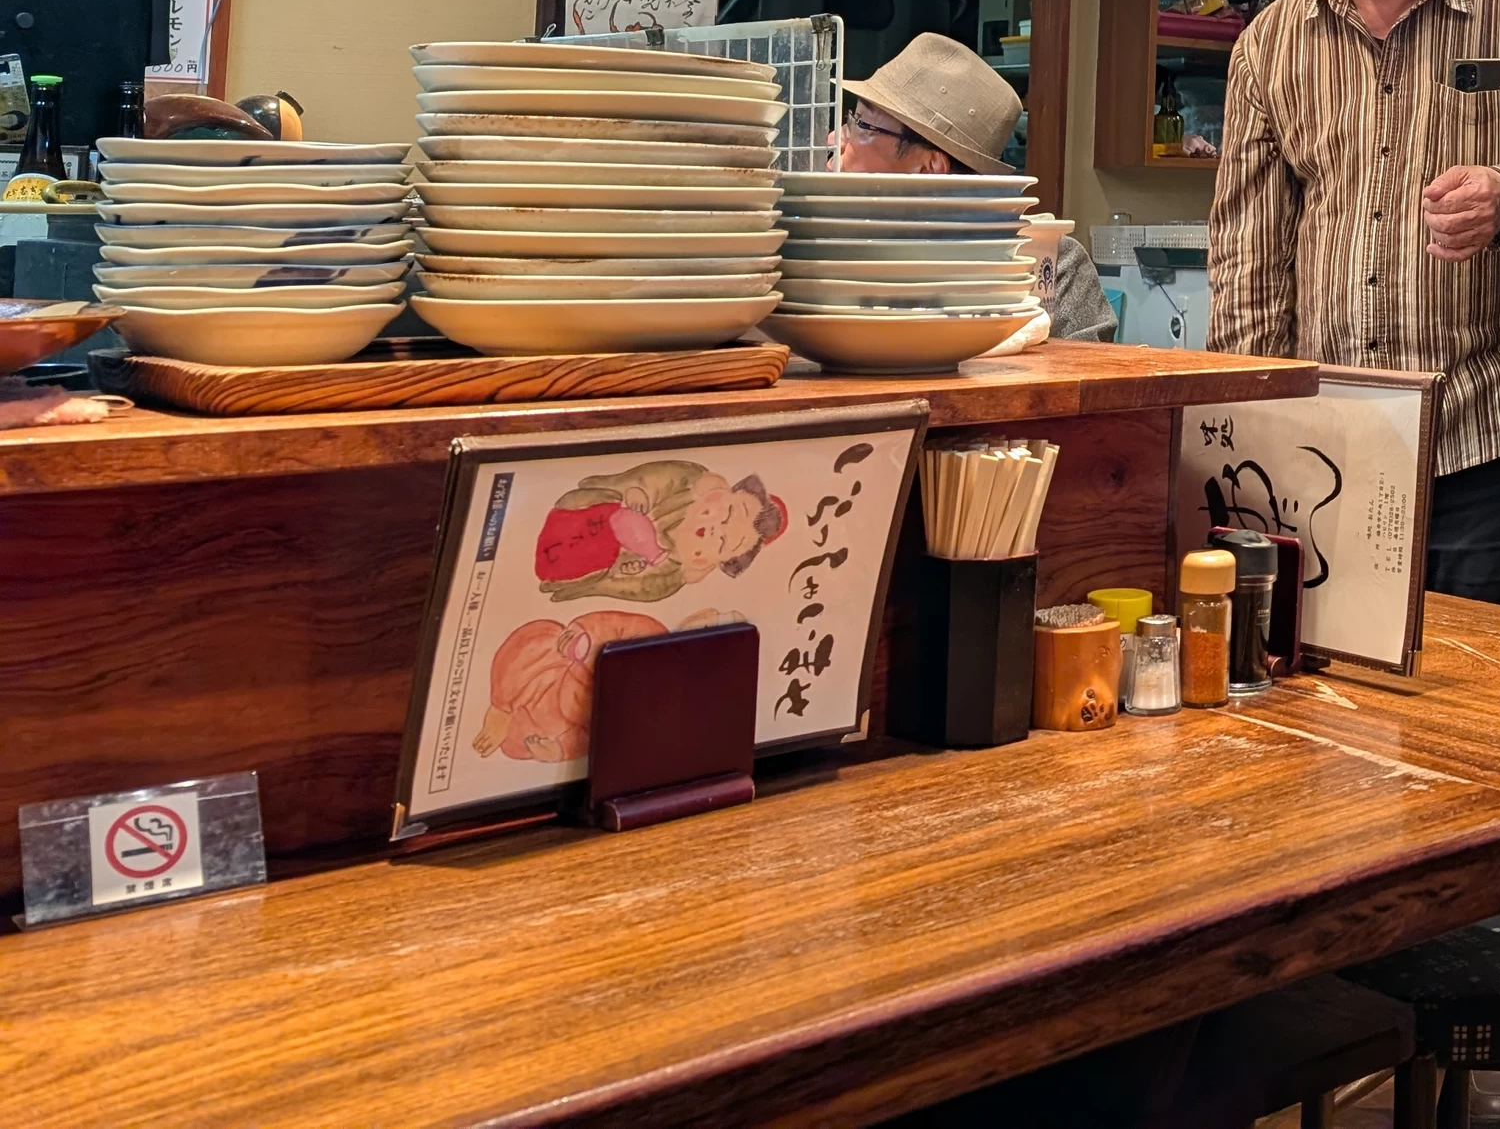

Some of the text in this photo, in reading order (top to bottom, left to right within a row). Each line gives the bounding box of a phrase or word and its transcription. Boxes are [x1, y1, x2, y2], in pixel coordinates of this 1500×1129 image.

[483, 477, 509, 558] お客様へのお願い
[774, 442, 875, 722] いらっしゃいませ
